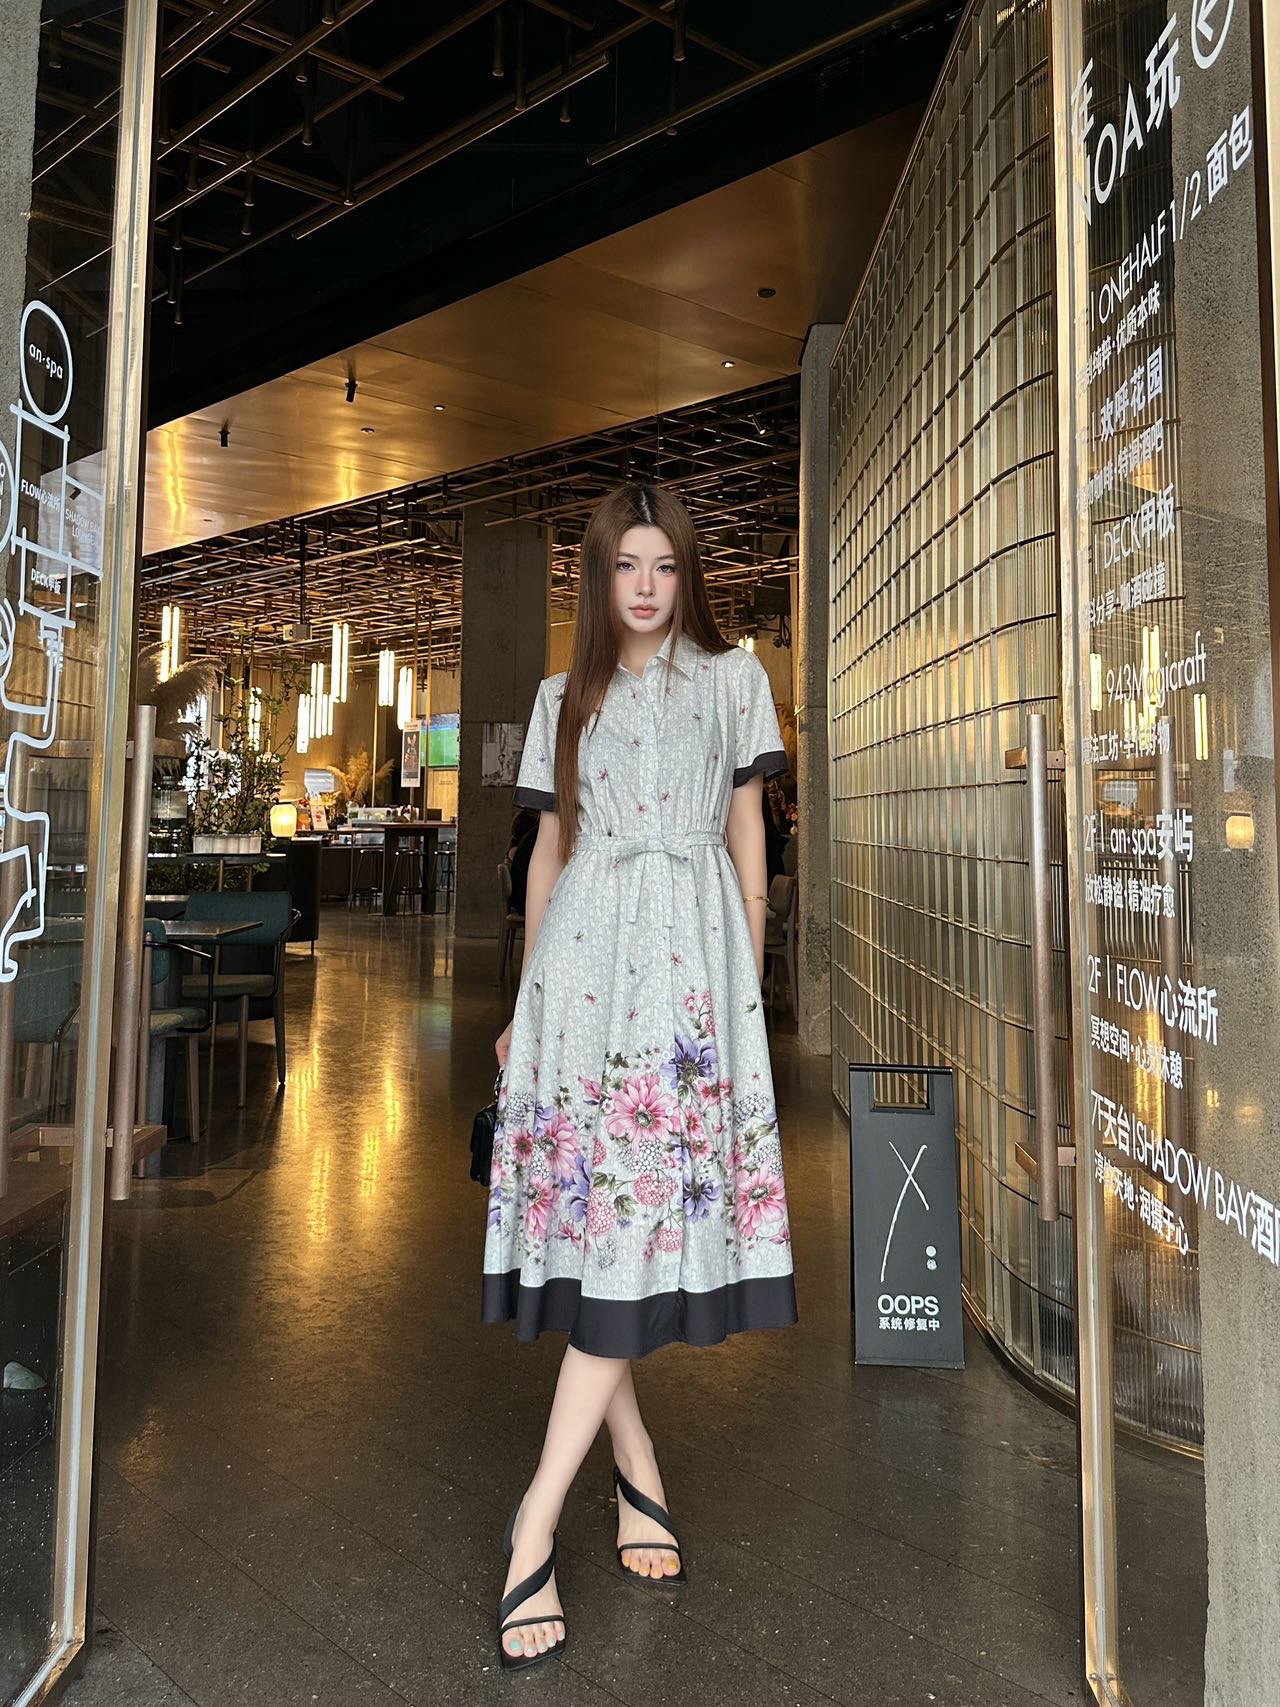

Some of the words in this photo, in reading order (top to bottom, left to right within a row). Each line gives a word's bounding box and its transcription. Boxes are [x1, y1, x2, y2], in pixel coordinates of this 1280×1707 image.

[1098, 209, 1166, 325] ONEHALF
[1100, 346, 1163, 442] 欢呼花园
[1104, 482, 1175, 569] DECK甲板
[1116, 963, 1219, 1046] FLOW心流所
[1214, 1170, 1280, 1268] BAY酒
[877, 1294, 939, 1316] OOPS
[879, 1316, 941, 1331] 系统修复中
